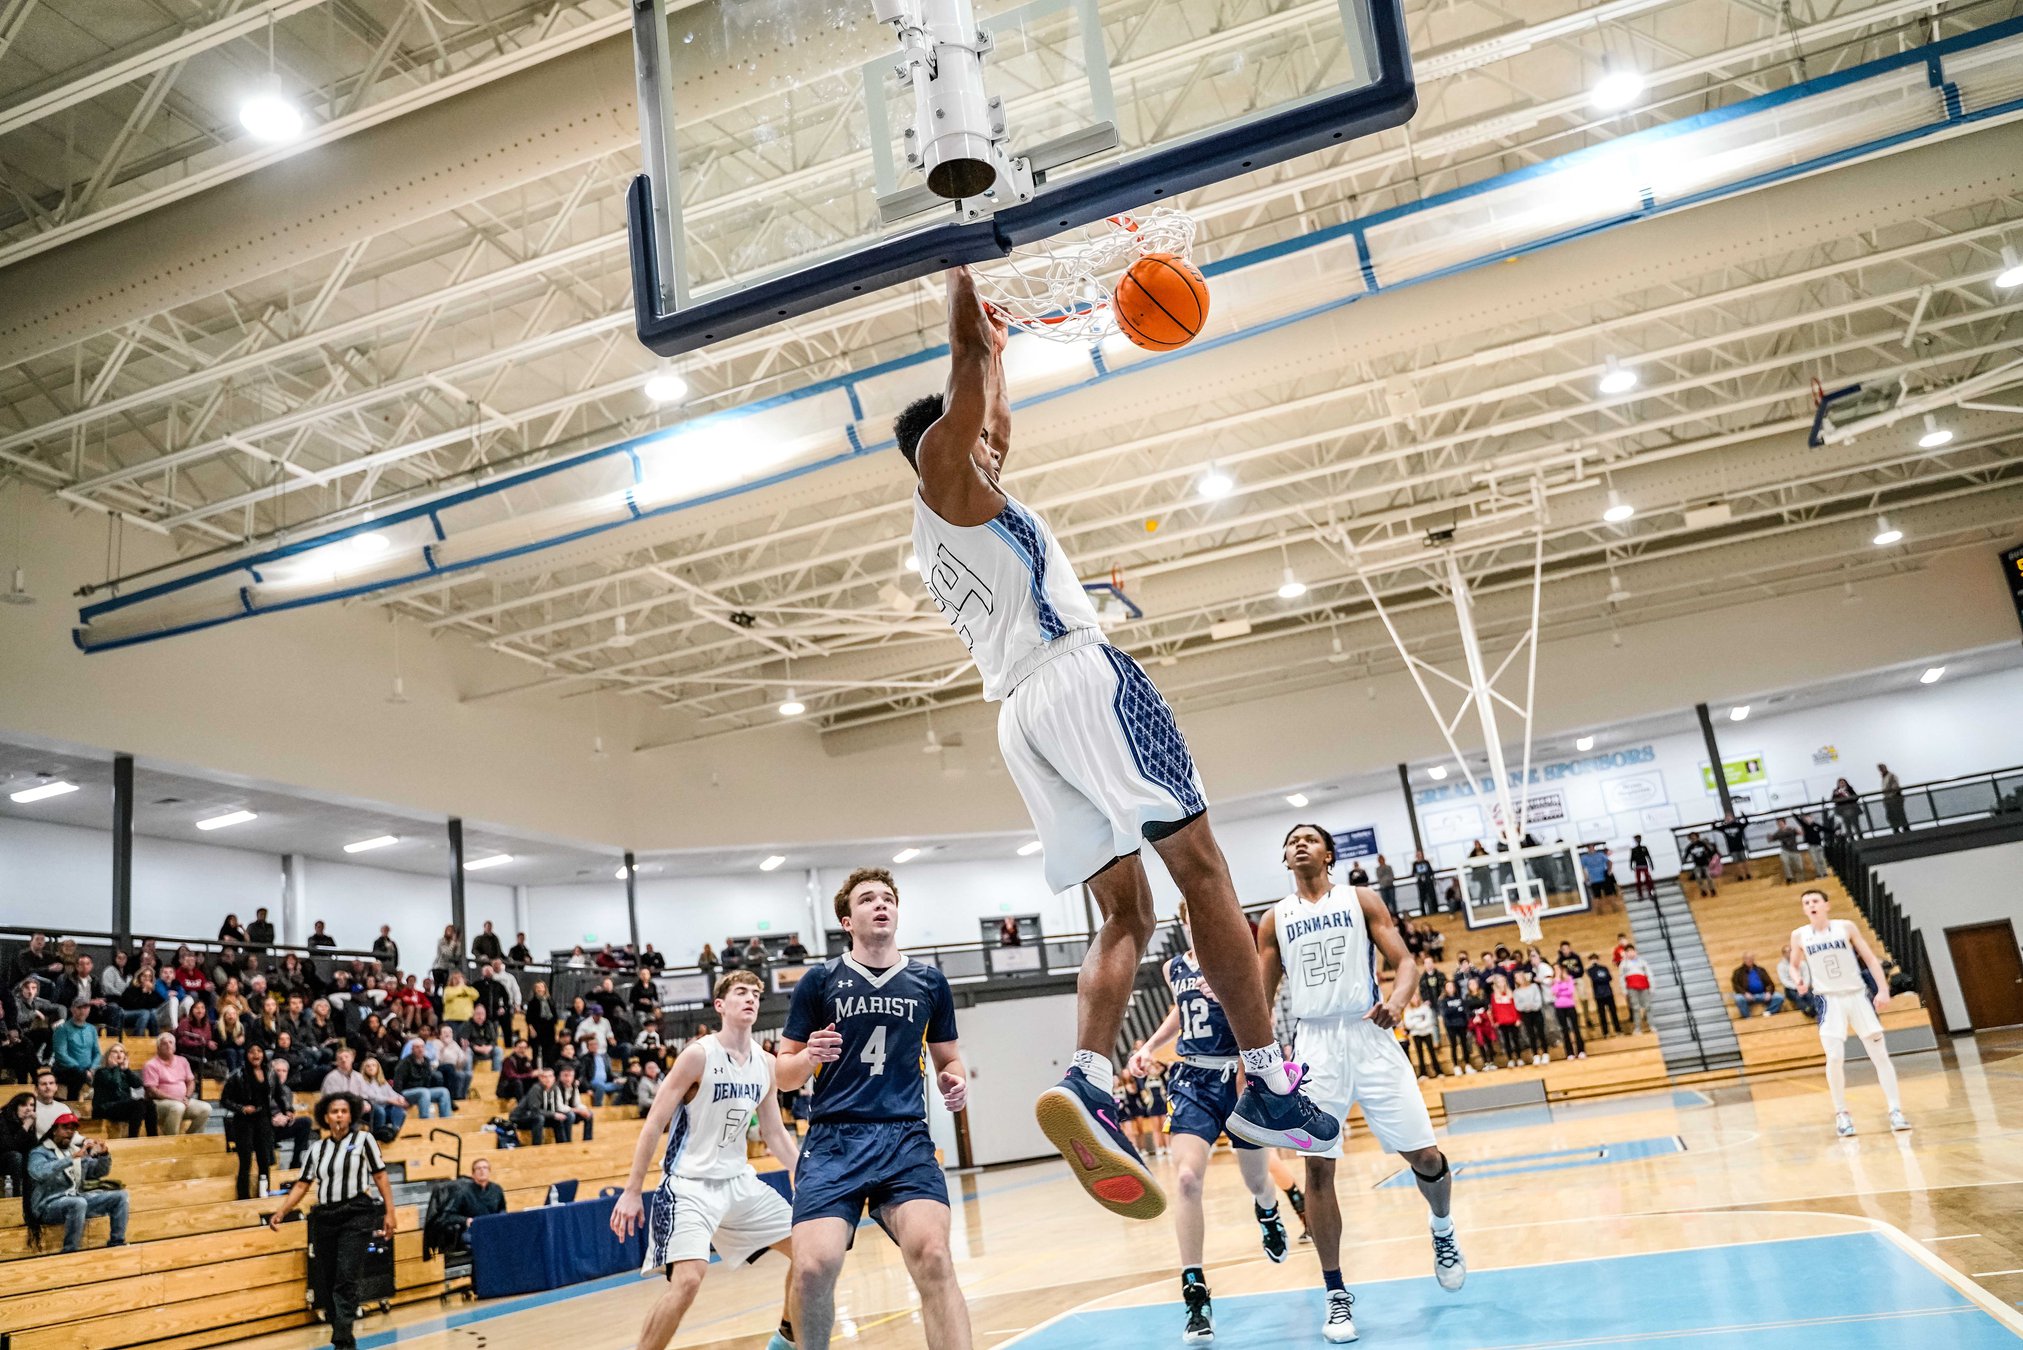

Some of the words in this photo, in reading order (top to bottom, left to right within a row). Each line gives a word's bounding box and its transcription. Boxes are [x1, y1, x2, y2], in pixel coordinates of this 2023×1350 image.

[1286, 909, 1353, 944] DENMARK
[1301, 935, 1346, 988] 25
[1806, 939, 1847, 956] DENMARK
[1823, 953, 1842, 979] 2
[834, 996, 918, 1023] MARIST
[1180, 997, 1213, 1041] 12
[860, 1025, 887, 1077] 4
